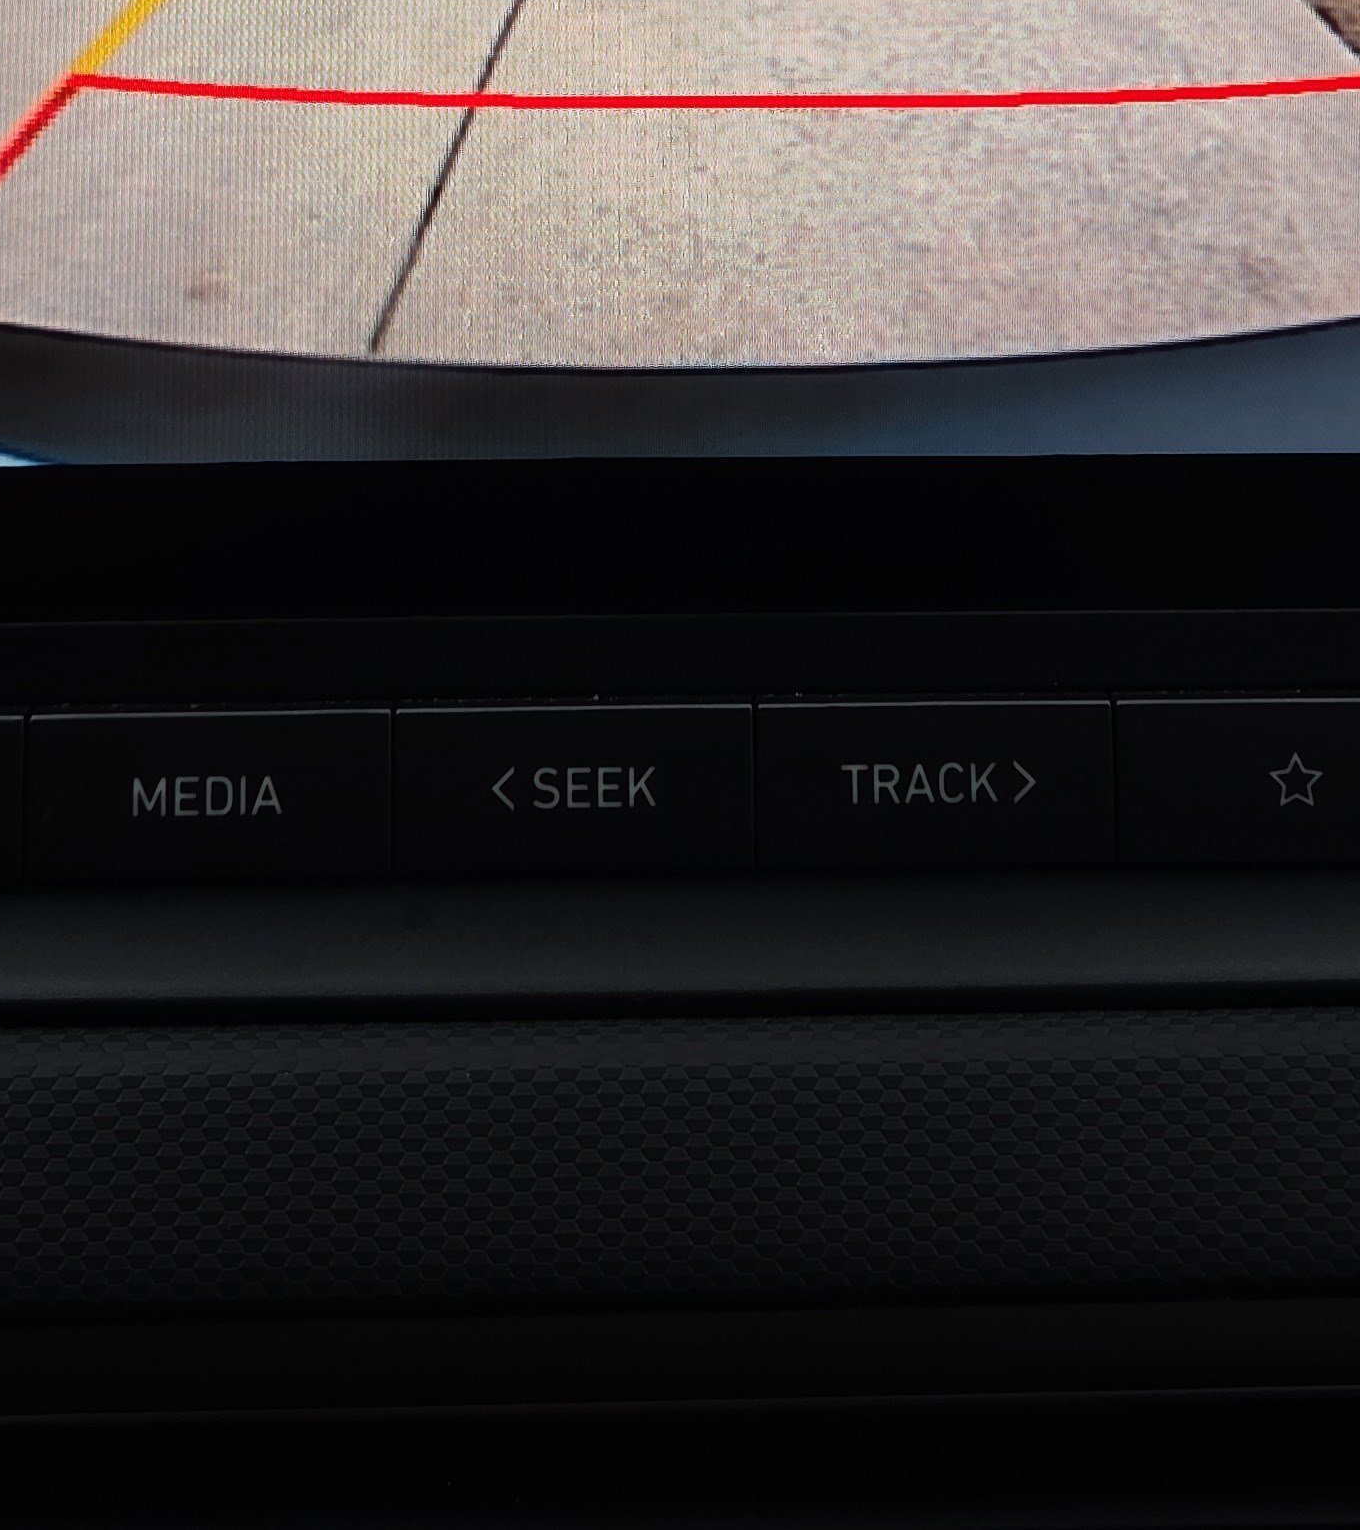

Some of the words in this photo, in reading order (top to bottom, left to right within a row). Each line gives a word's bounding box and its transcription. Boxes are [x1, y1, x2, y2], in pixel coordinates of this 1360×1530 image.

[131, 775, 283, 818] MEDIA
[533, 765, 657, 810] SEEK
[840, 761, 998, 805] TRACK
